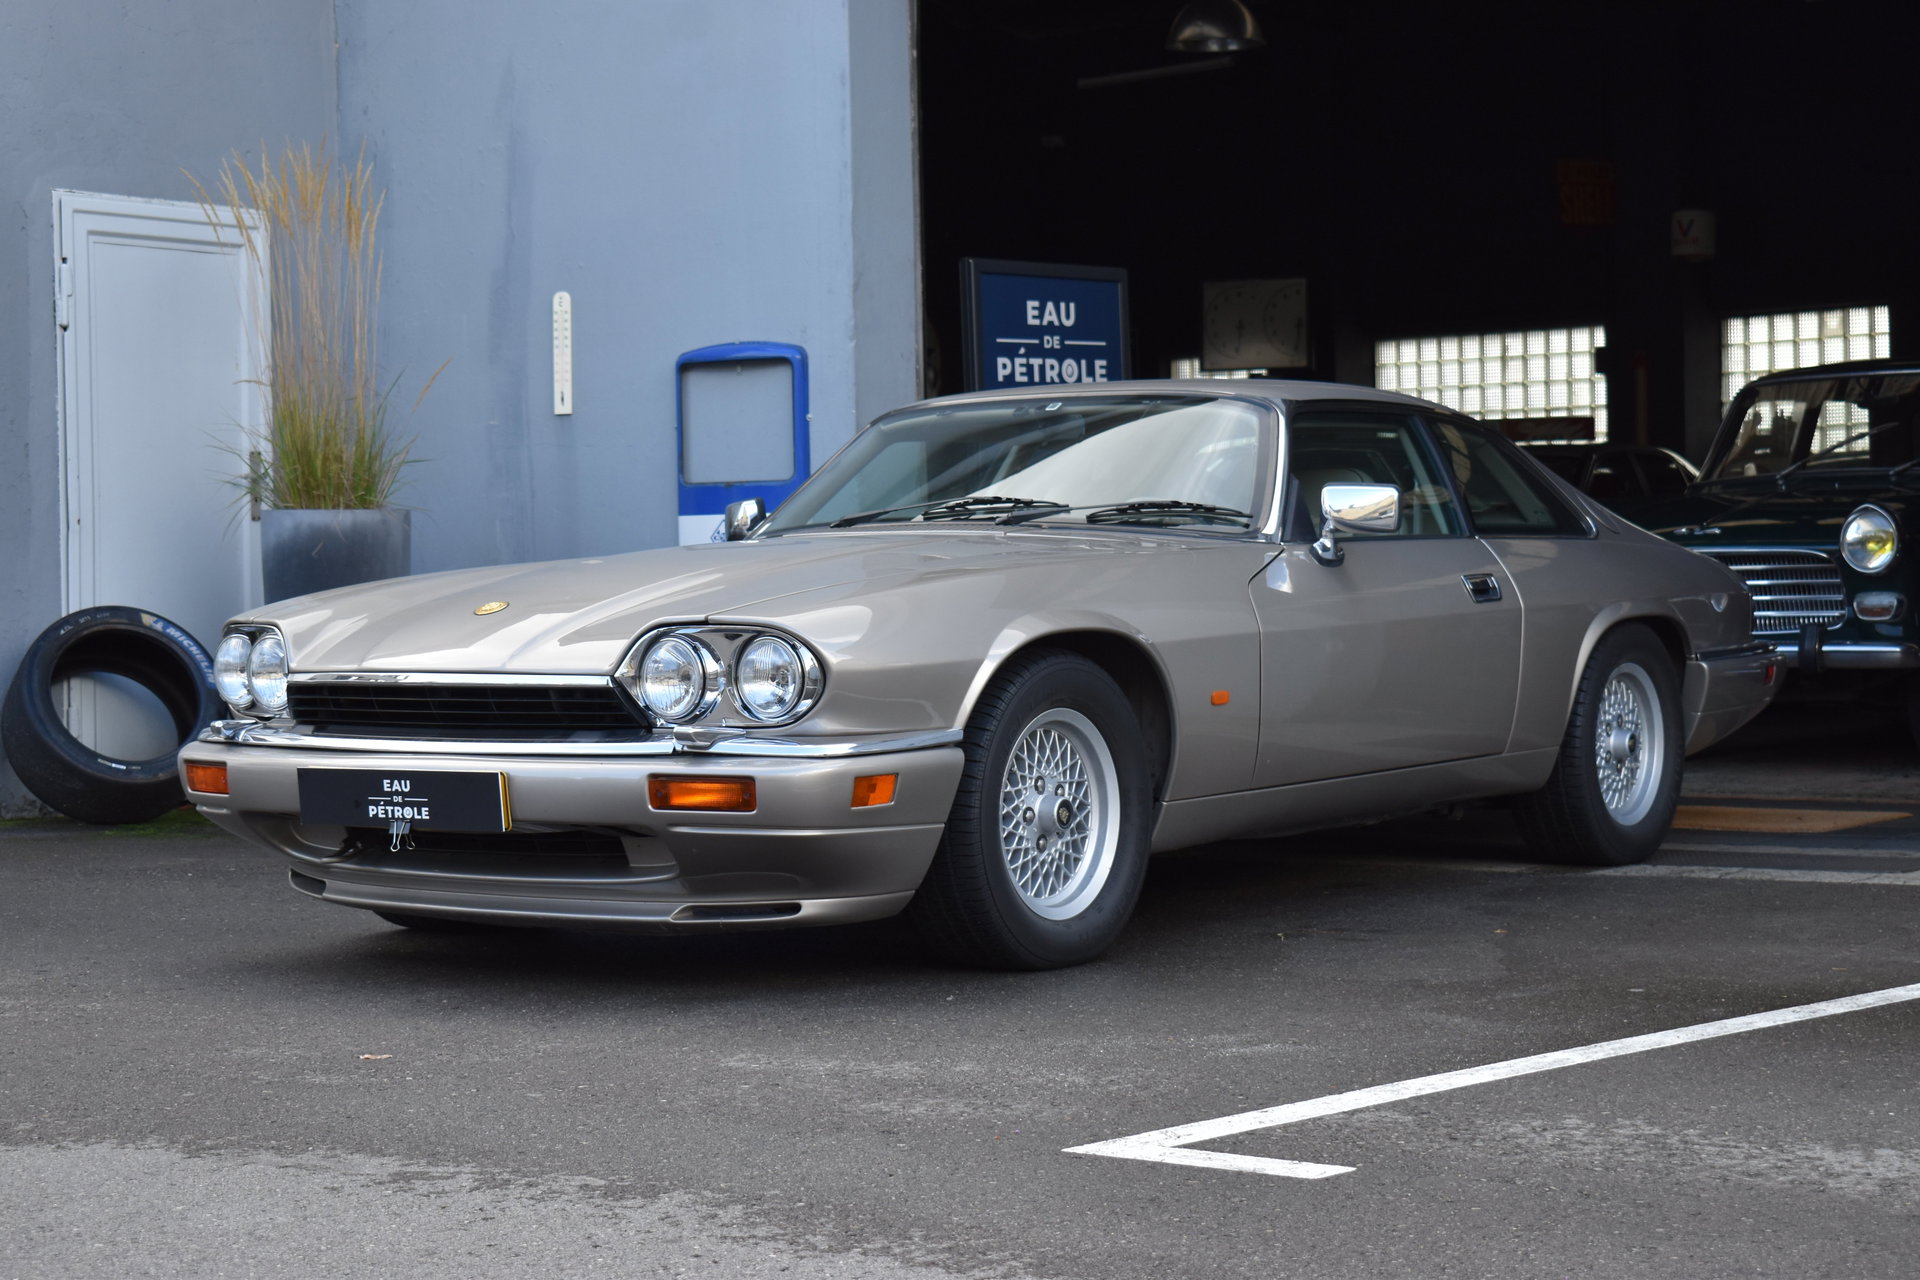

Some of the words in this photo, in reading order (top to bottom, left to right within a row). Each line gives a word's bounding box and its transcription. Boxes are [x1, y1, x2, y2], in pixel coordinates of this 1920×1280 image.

[1026, 300, 1076, 327] EAU
[1043, 335, 1061, 349] DE
[996, 346, 1108, 384] PÉTROLE
[166, 626, 216, 684] MICHELIN
[383, 779, 411, 792] EAU
[368, 801, 430, 819] PÉTROLE
